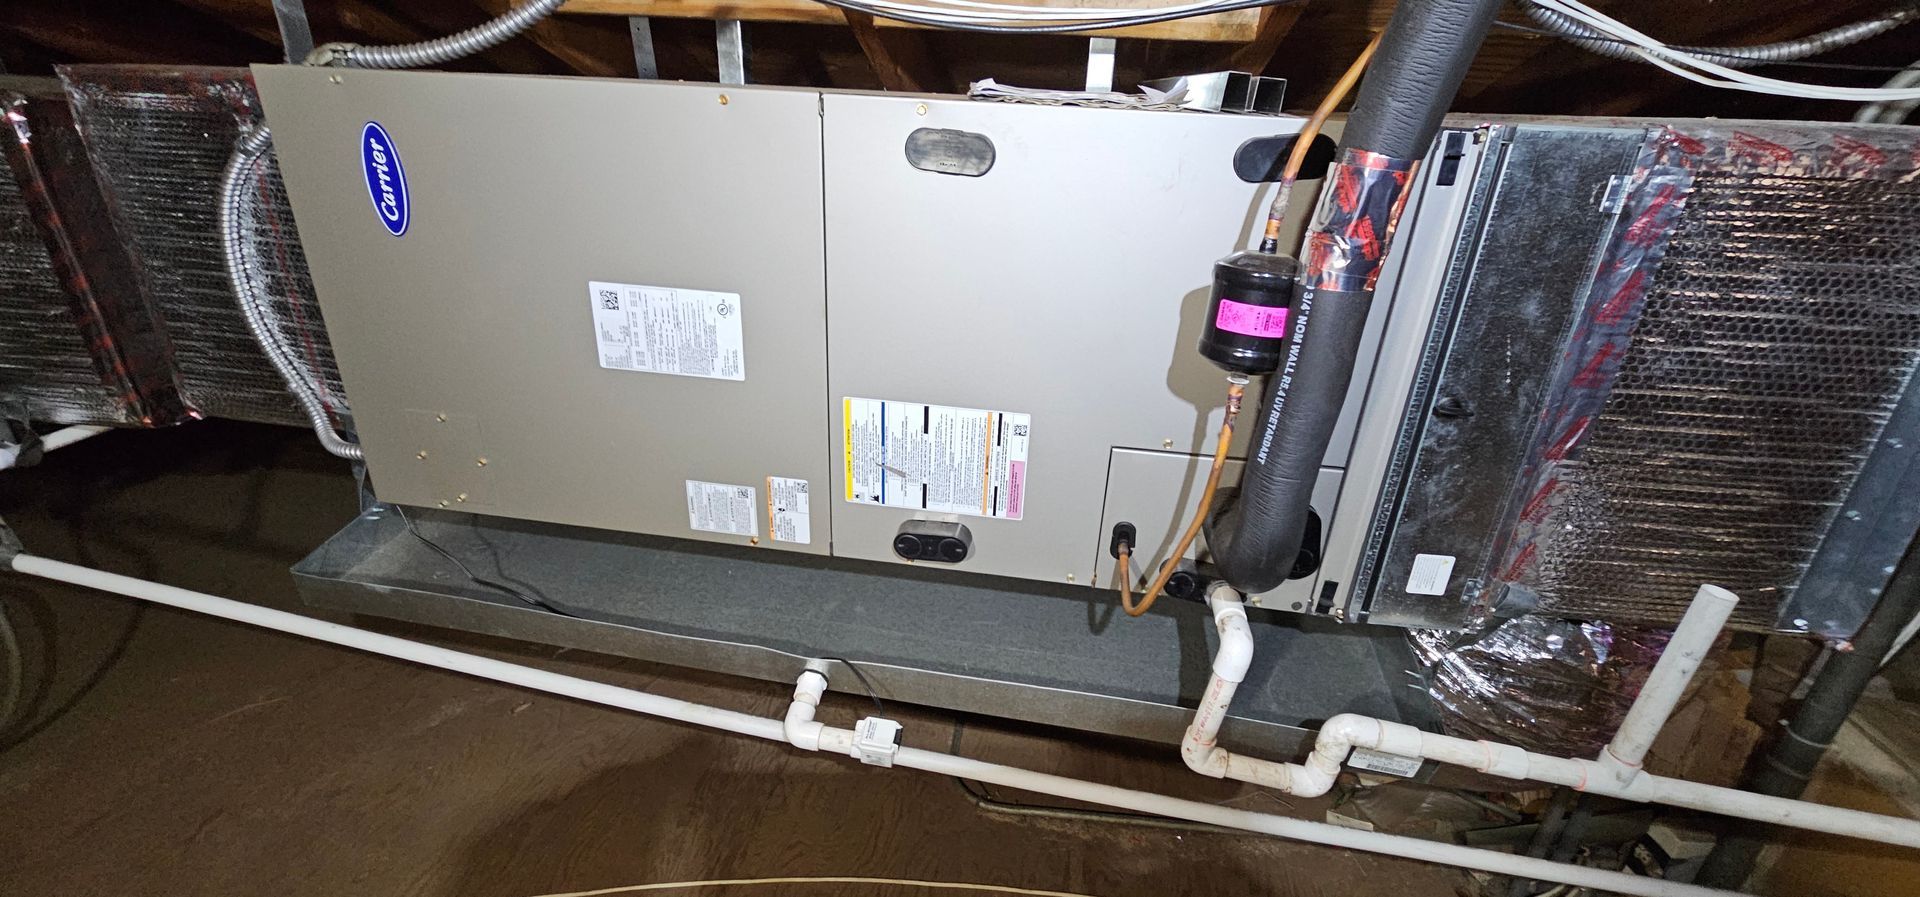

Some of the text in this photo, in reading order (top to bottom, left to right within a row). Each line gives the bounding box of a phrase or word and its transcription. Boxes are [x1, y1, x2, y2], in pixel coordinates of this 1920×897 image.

[370, 138, 399, 221] Carrier
[1293, 315, 1308, 343] NOM
[1284, 345, 1301, 374] WALL
[1277, 375, 1292, 397] R5.4
[1272, 397, 1285, 412] UV
[1257, 410, 1280, 465] RETARDANT
